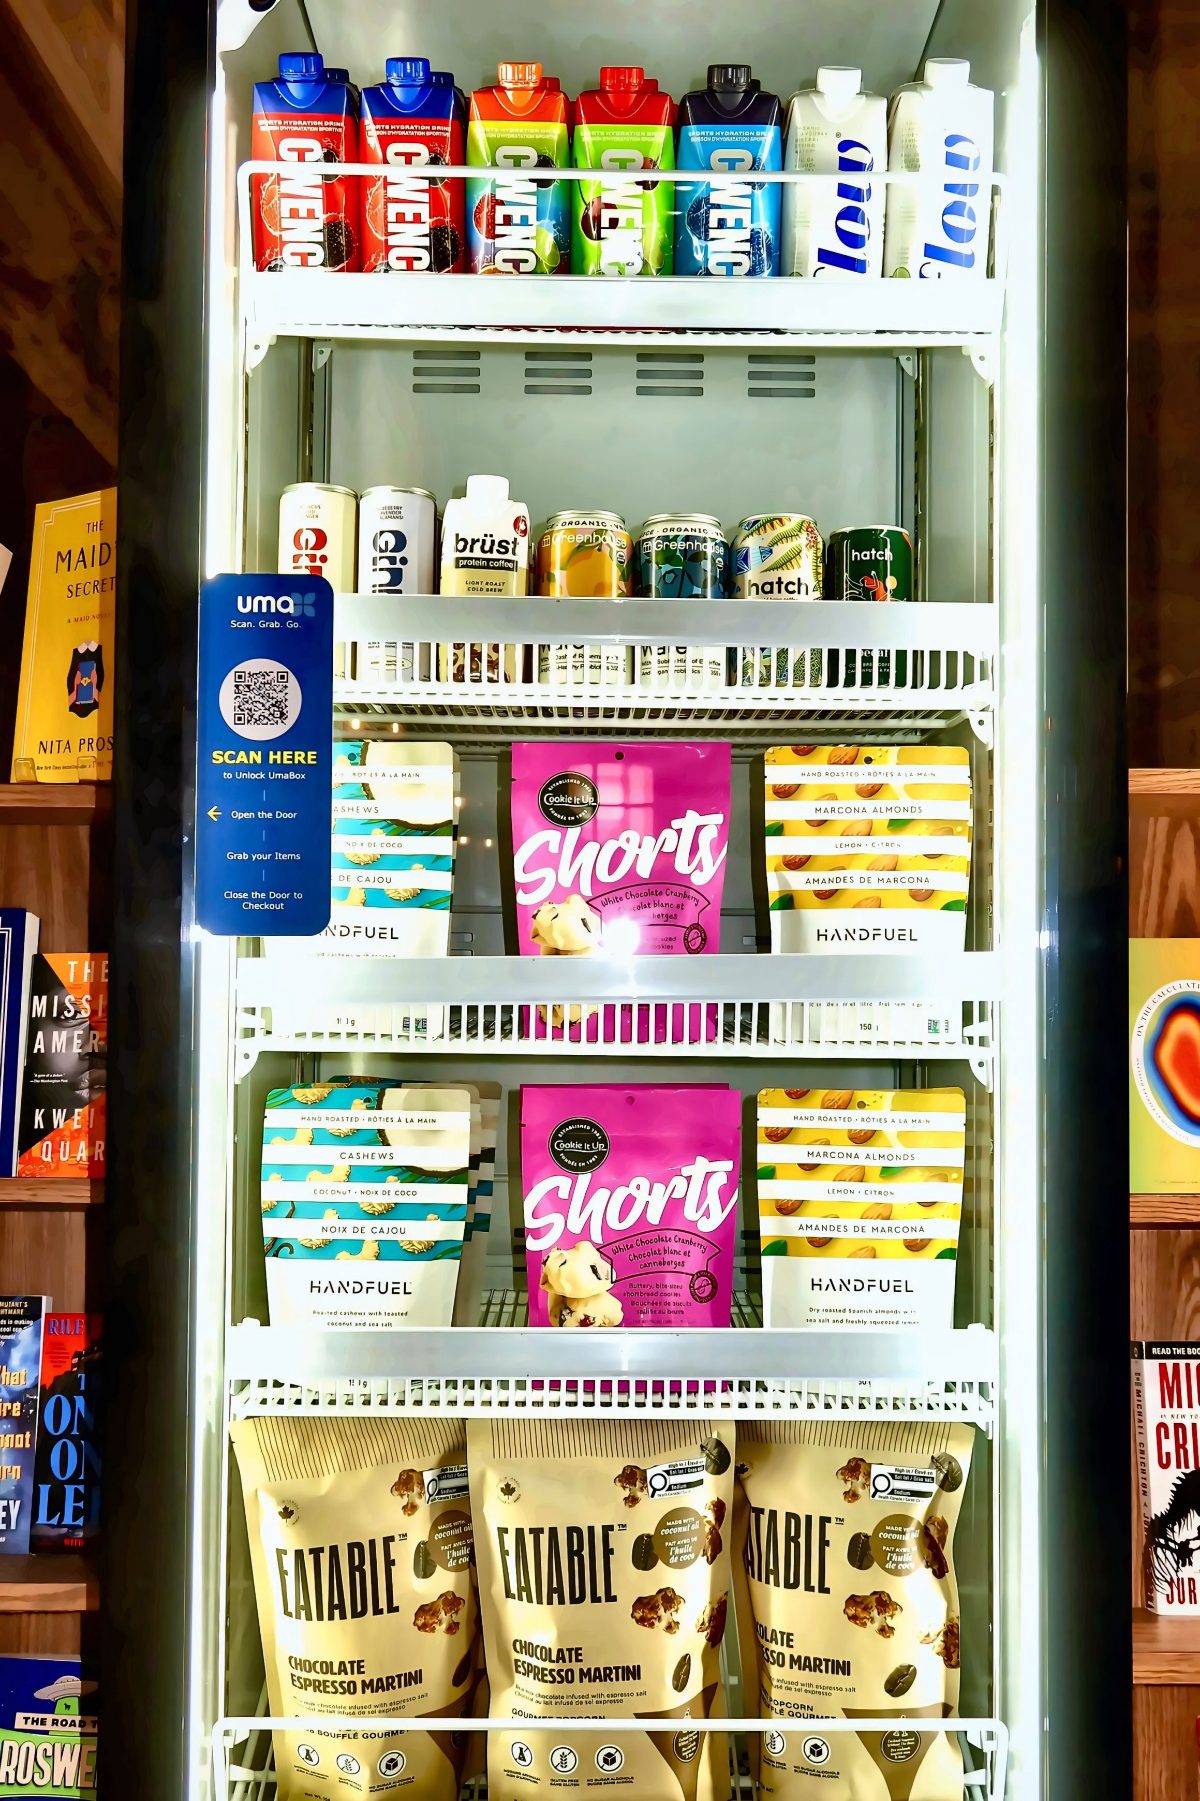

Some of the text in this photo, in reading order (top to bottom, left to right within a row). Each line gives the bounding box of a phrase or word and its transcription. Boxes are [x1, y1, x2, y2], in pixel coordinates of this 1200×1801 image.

[86, 519, 104, 534] THE
[561, 520, 608, 528] ORGANIC
[662, 526, 709, 534] ORGANIC
[453, 532, 520, 557] brüst
[655, 539, 725, 555] Greenhouse
[851, 547, 893, 562] hatch
[458, 557, 514, 569] protein coffee
[485, 580, 506, 588] ROAST
[748, 577, 809, 596] hatch
[236, 595, 295, 614] uma
[230, 619, 302, 629] Scan. Grab. Go.
[38, 739, 72, 755] NITA
[212, 750, 317, 765] SCAN HERE
[223, 772, 306, 780] to Unlock UmaBox
[543, 793, 595, 806] Cookie Up
[231, 810, 298, 821] Open the Door
[814, 805, 923, 815] MARCONA ALMONDS
[226, 851, 301, 862] Grab your Items
[513, 809, 729, 906] Shorts
[356, 875, 393, 884] CAJOU
[804, 875, 931, 885] AMANDES DE MARCONA
[223, 891, 303, 900] Close the Door to
[601, 895, 624, 908] White
[625, 888, 663, 900] Chocolate
[665, 888, 700, 907] Cranberry
[242, 901, 285, 910] Checkout
[653, 900, 674, 909] blanc
[816, 928, 918, 942] HANDFUEL
[1141, 1005, 1152, 1021] THE
[34, 1107, 96, 1130] KWEI
[817, 1115, 853, 1123] ROASTED
[860, 1116, 889, 1124] RÔTIES
[554, 1139, 605, 1151] Cookie It Up
[339, 1151, 395, 1161] CASHEWS
[807, 1150, 916, 1161] MARCONA ALMONDS
[523, 1155, 739, 1252] Shorts
[321, 1225, 407, 1236] NOIX DE CAJOU
[798, 1223, 926, 1234] AMANDES DE MARCONA
[611, 1234, 708, 1256] White Chocolate Cranberry
[628, 1246, 691, 1262] Chocolat blanc et
[639, 1258, 685, 1270] canneberges
[309, 1280, 413, 1295] HANDFUEL
[811, 1277, 914, 1293] HANDFUEL
[848, 1307, 873, 1315] Spanish
[845, 1318, 868, 1326] freshly
[1151, 1347, 1186, 1355] READ THE
[0, 1365, 27, 1386] hat
[1138, 1442, 1148, 1497] CRICHTON
[660, 1523, 691, 1536] coconut
[669, 1545, 693, 1556] l'huile
[669, 1553, 695, 1564] de coco
[496, 1524, 618, 1606] EATABLE
[275, 1534, 400, 1622] EATABLE
[1166, 1574, 1198, 1605] JUR
[512, 1638, 583, 1664] CHOCOLATE
[288, 1655, 366, 1676] CHOCOLATE
[513, 1658, 642, 1685] ESPRESSO MARTINI
[788, 1654, 851, 1677] MARTINI
[290, 1668, 423, 1696] ESPRESSO MARTINI
[799, 1681, 814, 1689] with
[815, 1683, 844, 1692] espresso
[535, 1691, 565, 1700] chocolate
[565, 1692, 590, 1700] infused
[803, 1688, 833, 1697] expresso
[389, 1696, 417, 1707] espresso
[554, 1698, 624, 1706] infusé expresso
[378, 1704, 406, 1715] expresso
[22, 1716, 87, 1729] THE ROAD
